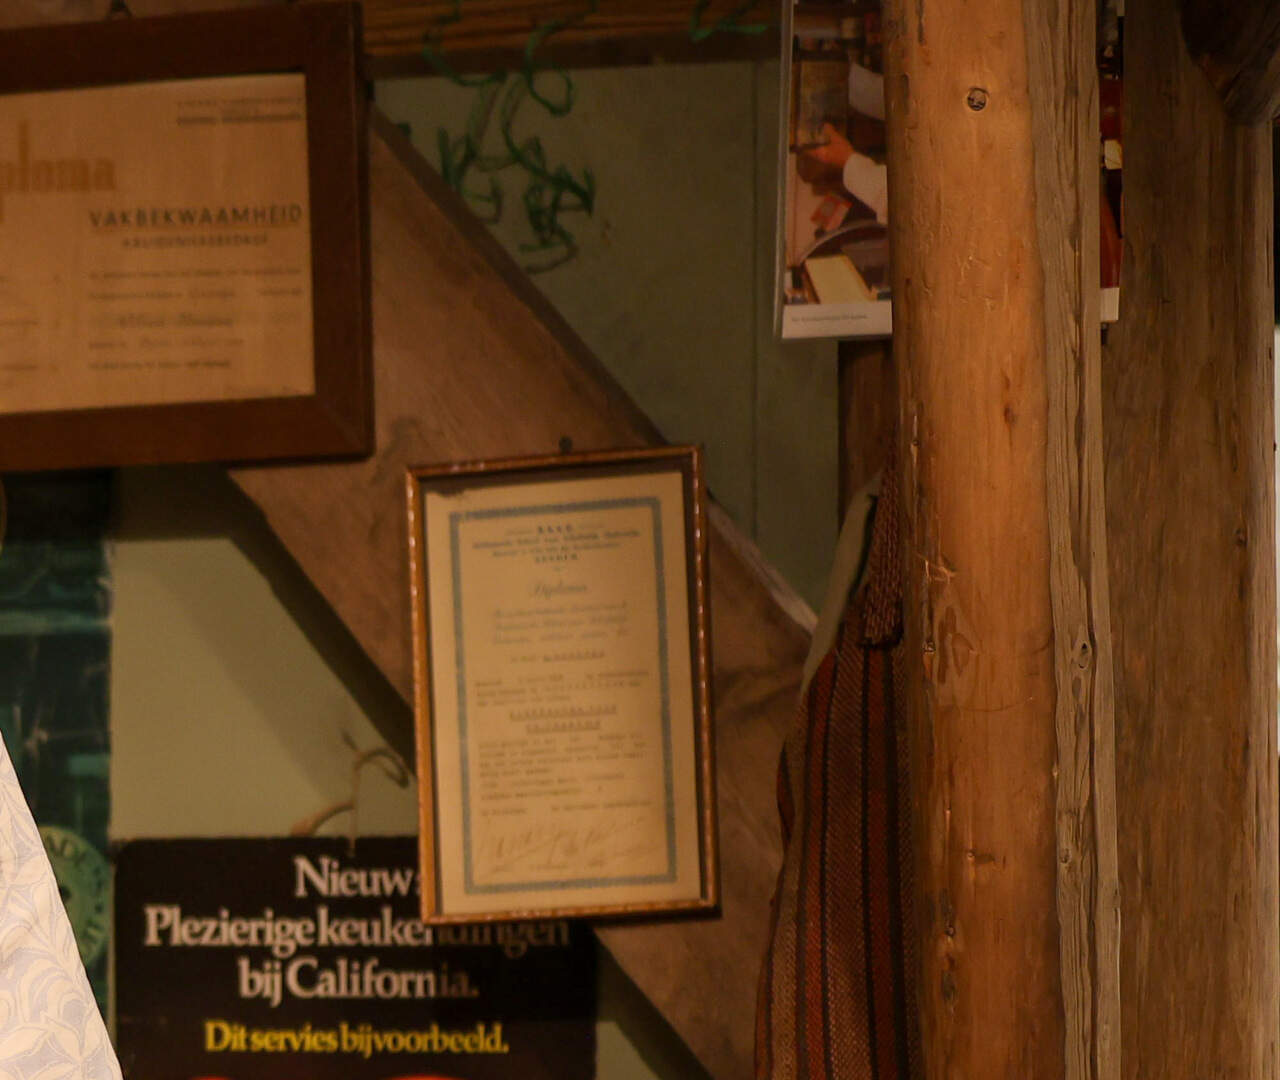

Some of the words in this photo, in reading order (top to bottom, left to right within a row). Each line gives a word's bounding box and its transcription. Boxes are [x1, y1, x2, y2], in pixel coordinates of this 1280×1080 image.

[89, 203, 303, 228] VAKBEKWAAMHEID
[293, 855, 420, 898] Nieuw
[144, 904, 316, 958] Plezierige
[238, 956, 283, 1008] bij
[287, 956, 480, 1000] California.
[205, 1020, 249, 1053] Dit
[250, 1024, 338, 1054] servies
[342, 1020, 509, 1060] bijvoorbeeld.
